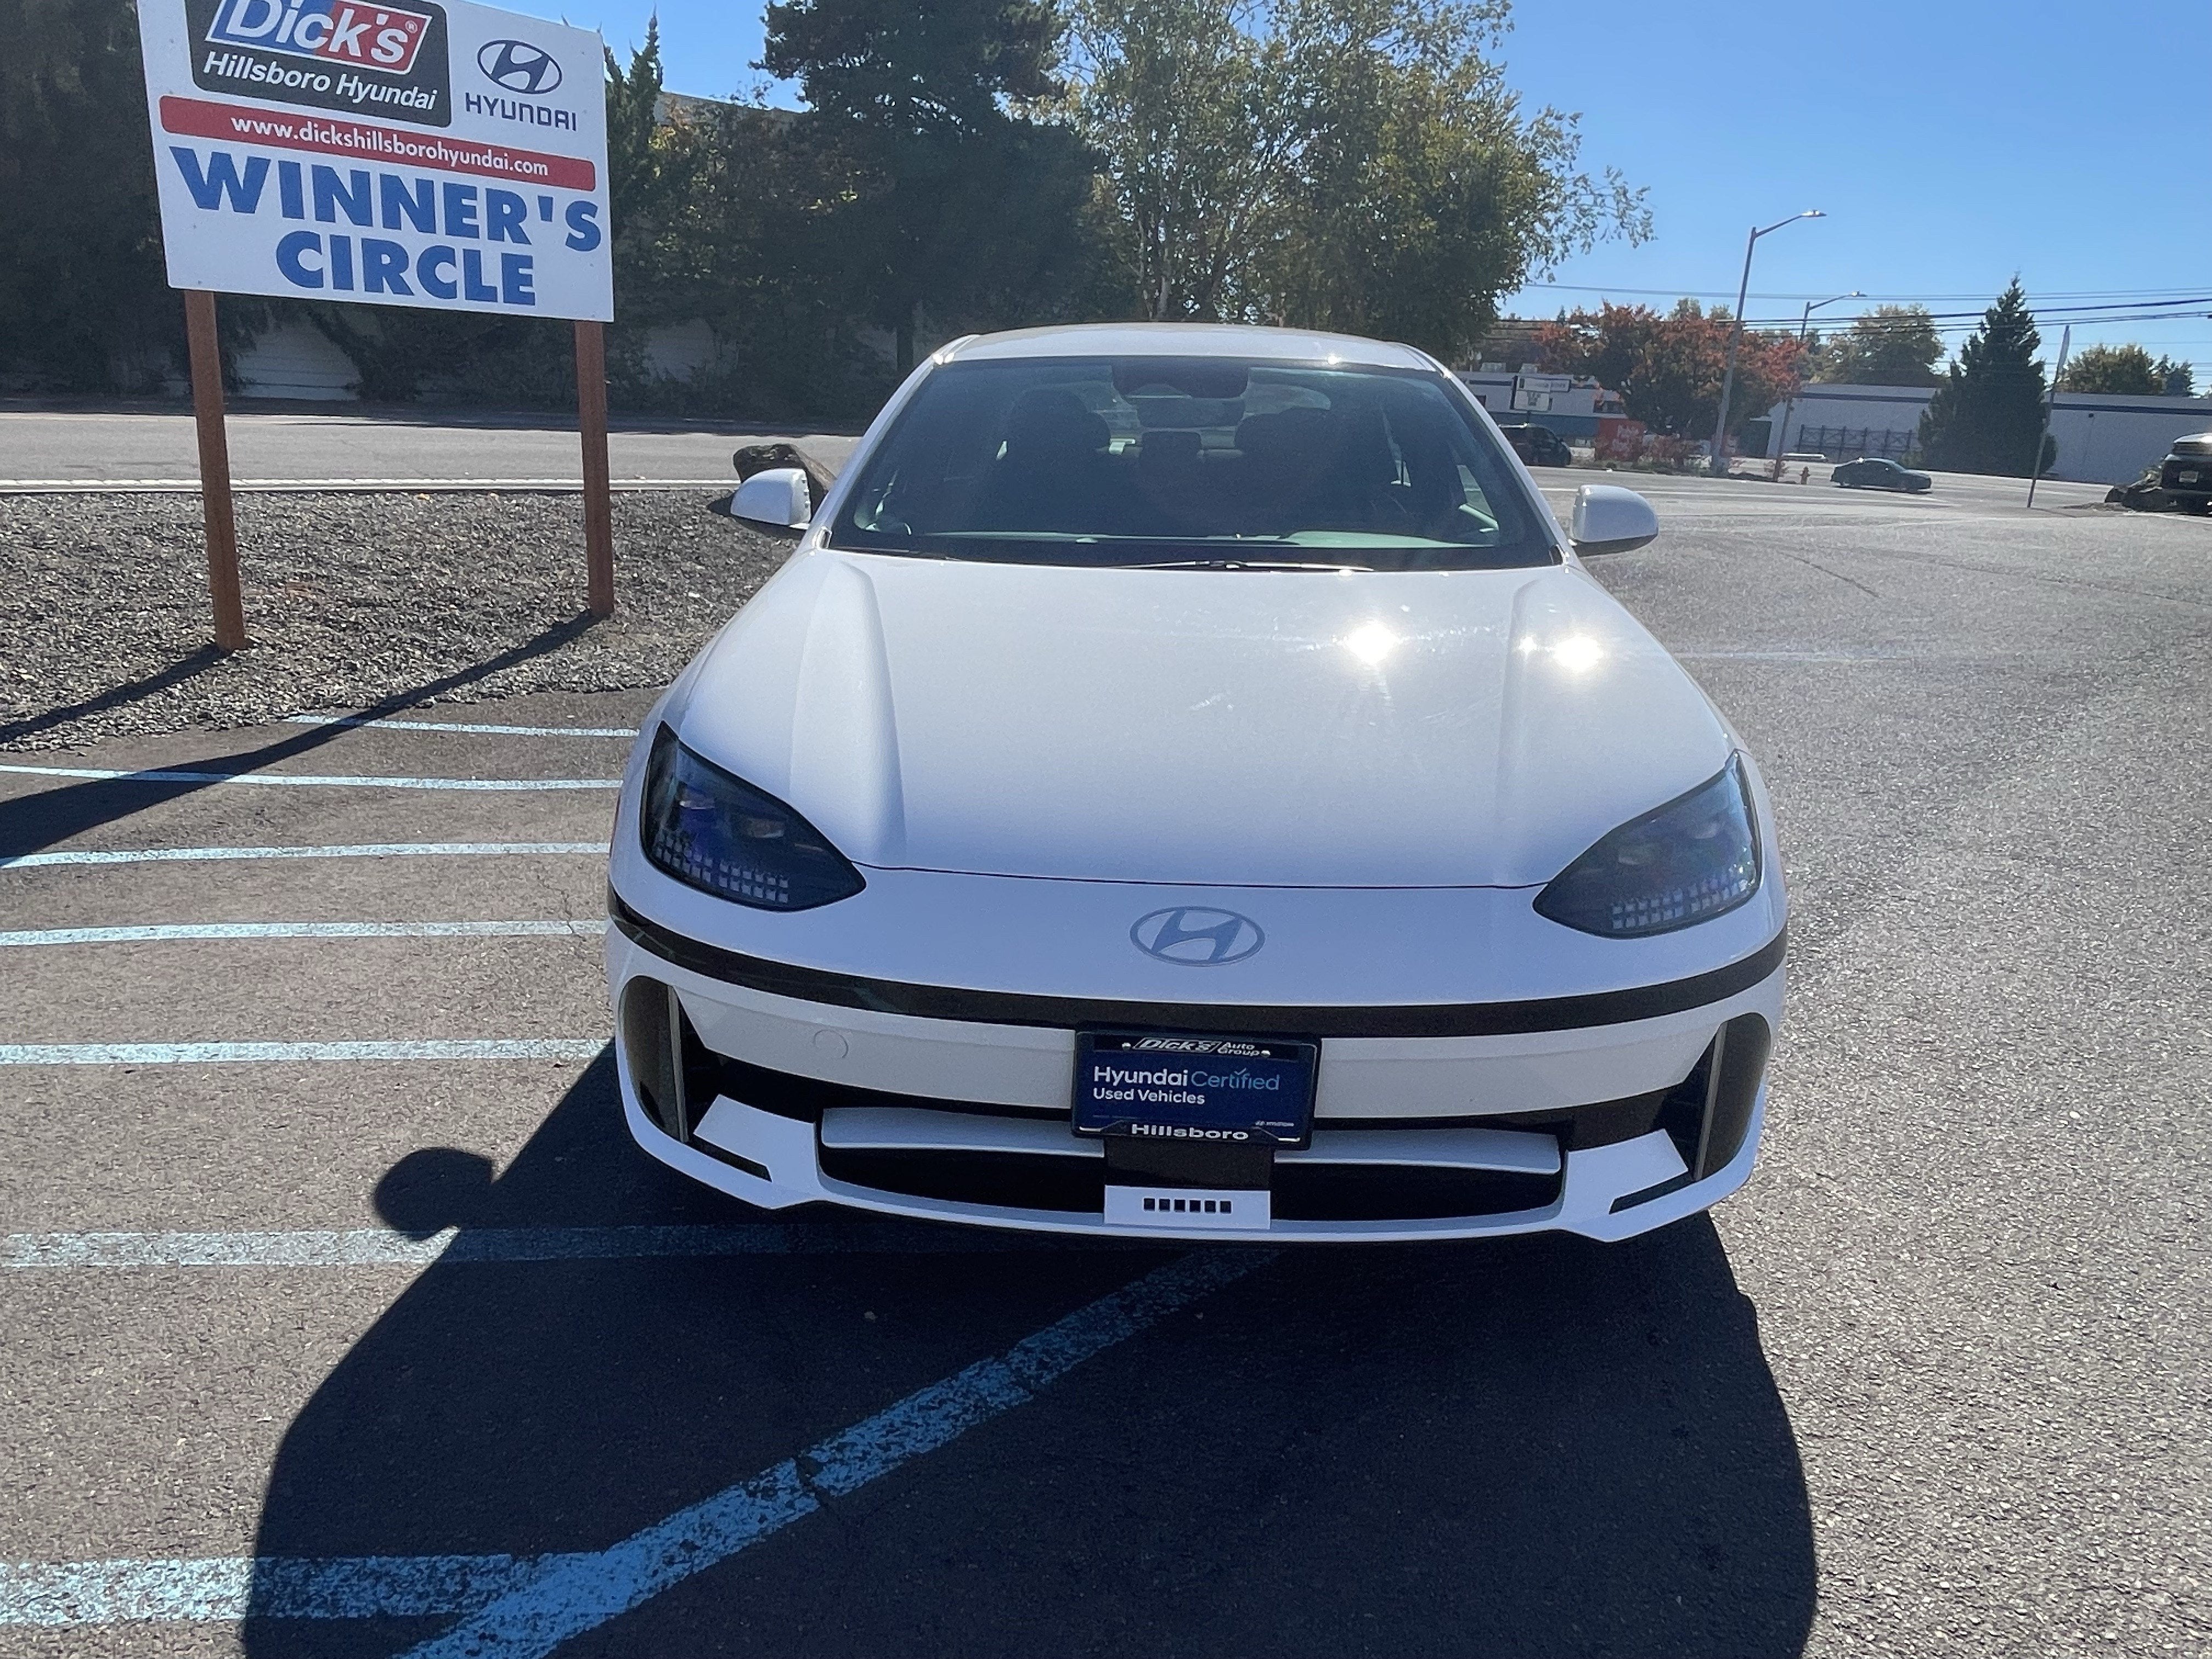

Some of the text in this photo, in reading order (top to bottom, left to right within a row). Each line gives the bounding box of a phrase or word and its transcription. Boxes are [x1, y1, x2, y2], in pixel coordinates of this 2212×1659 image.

[225, 0, 408, 64] Dick's
[203, 50, 438, 110] Hillsboro Hyundai
[465, 92, 577, 132] HYUNDAI
[230, 116, 549, 177] www.dickshillsborohyundai.com
[169, 146, 601, 251] WINNER'S
[275, 230, 536, 306] CIRCLE
[1217, 1047, 1260, 1057] Group
[1224, 1041, 1255, 1051] Auto
[1093, 1066, 1280, 1091] Hyundai Certified
[1093, 1087, 1205, 1105] Used Vehicles
[1131, 1123, 1249, 1140] Hillsboro
